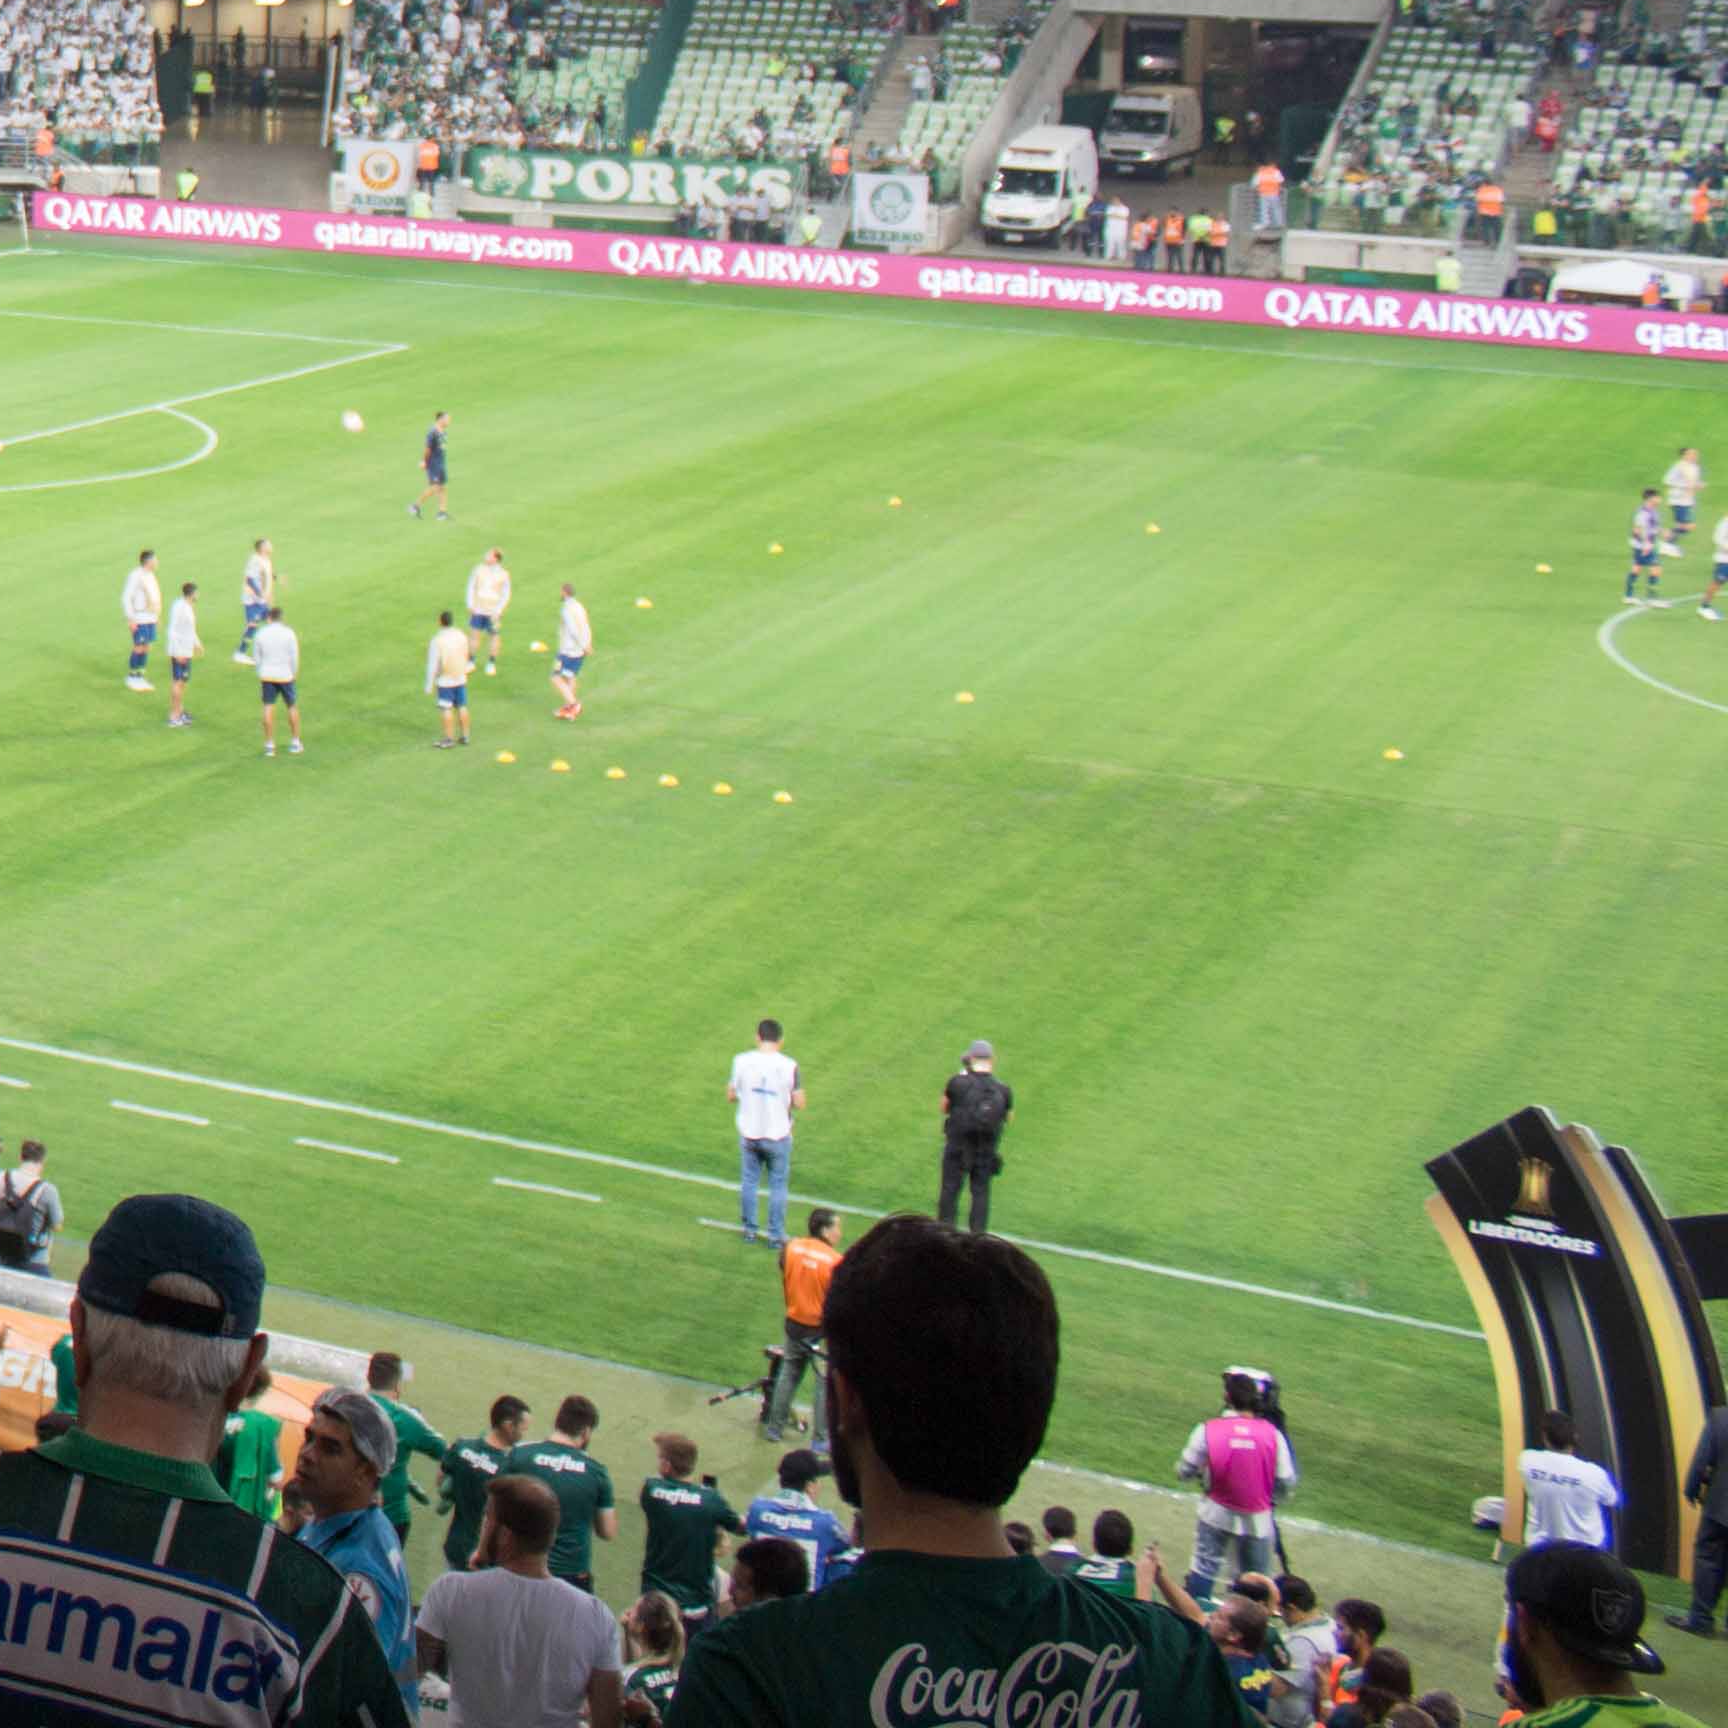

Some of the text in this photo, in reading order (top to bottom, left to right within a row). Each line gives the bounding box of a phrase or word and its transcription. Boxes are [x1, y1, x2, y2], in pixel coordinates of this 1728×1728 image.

[44, 198, 282, 242] QATAR AIRWAYS
[315, 220, 574, 263] qatarairways.com
[608, 238, 880, 289] QATAR AIRWAYS
[919, 266, 1224, 314] qatarairways.com
[1263, 288, 1590, 344] QATAR AIRWAYS
[1635, 320, 1728, 355] qata
[1468, 1219, 1597, 1257] LIBERTADORES
[1528, 1468, 1582, 1488] STAFF
[869, 1641, 1143, 1728] Coca Cola
